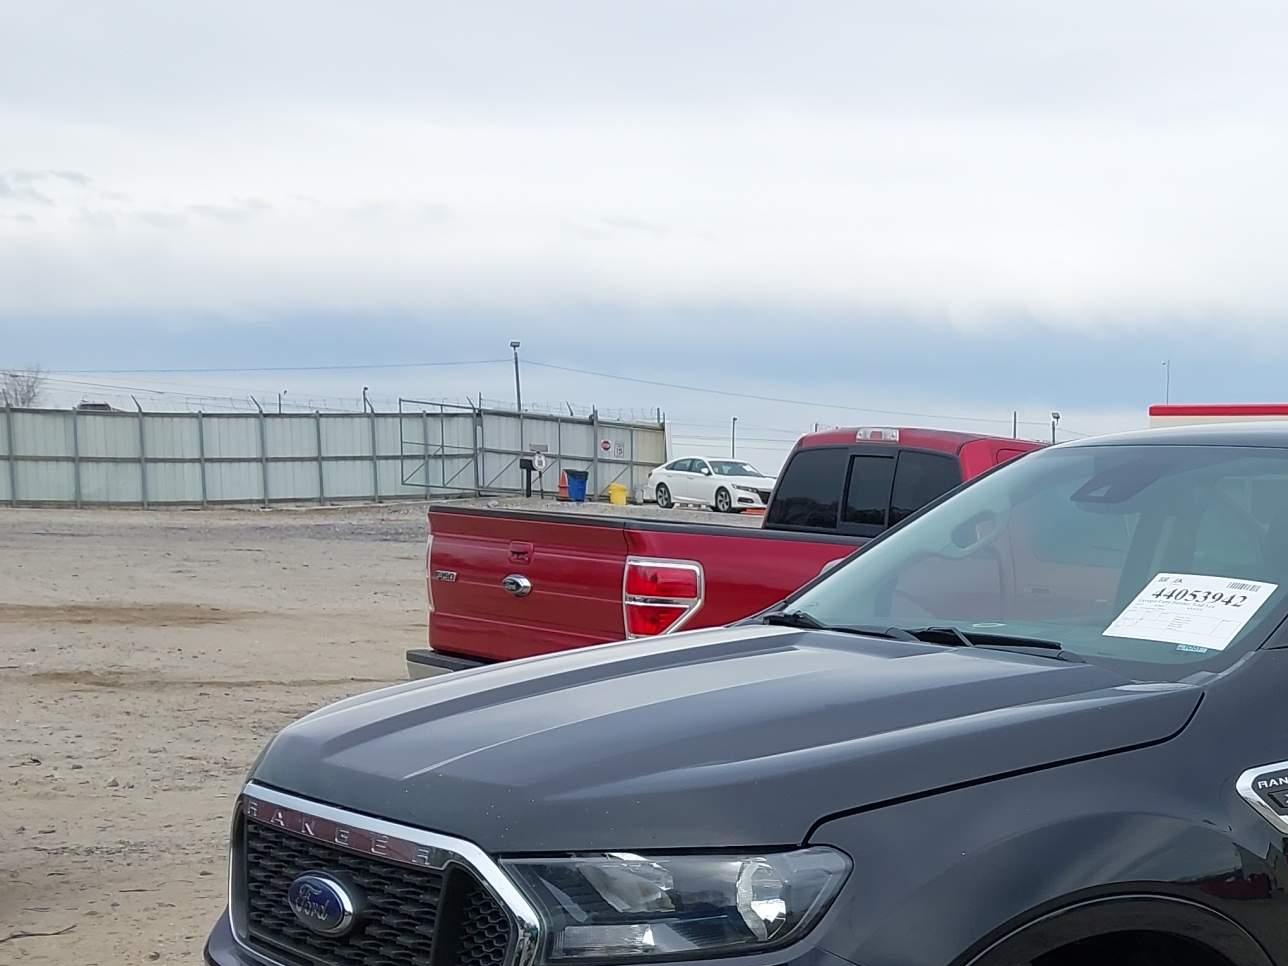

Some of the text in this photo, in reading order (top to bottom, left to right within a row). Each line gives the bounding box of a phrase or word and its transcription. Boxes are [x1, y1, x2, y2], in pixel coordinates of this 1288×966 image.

[1152, 588, 1247, 607] 44053942
[247, 801, 431, 866] RANGER
[295, 883, 331, 921] Ford
